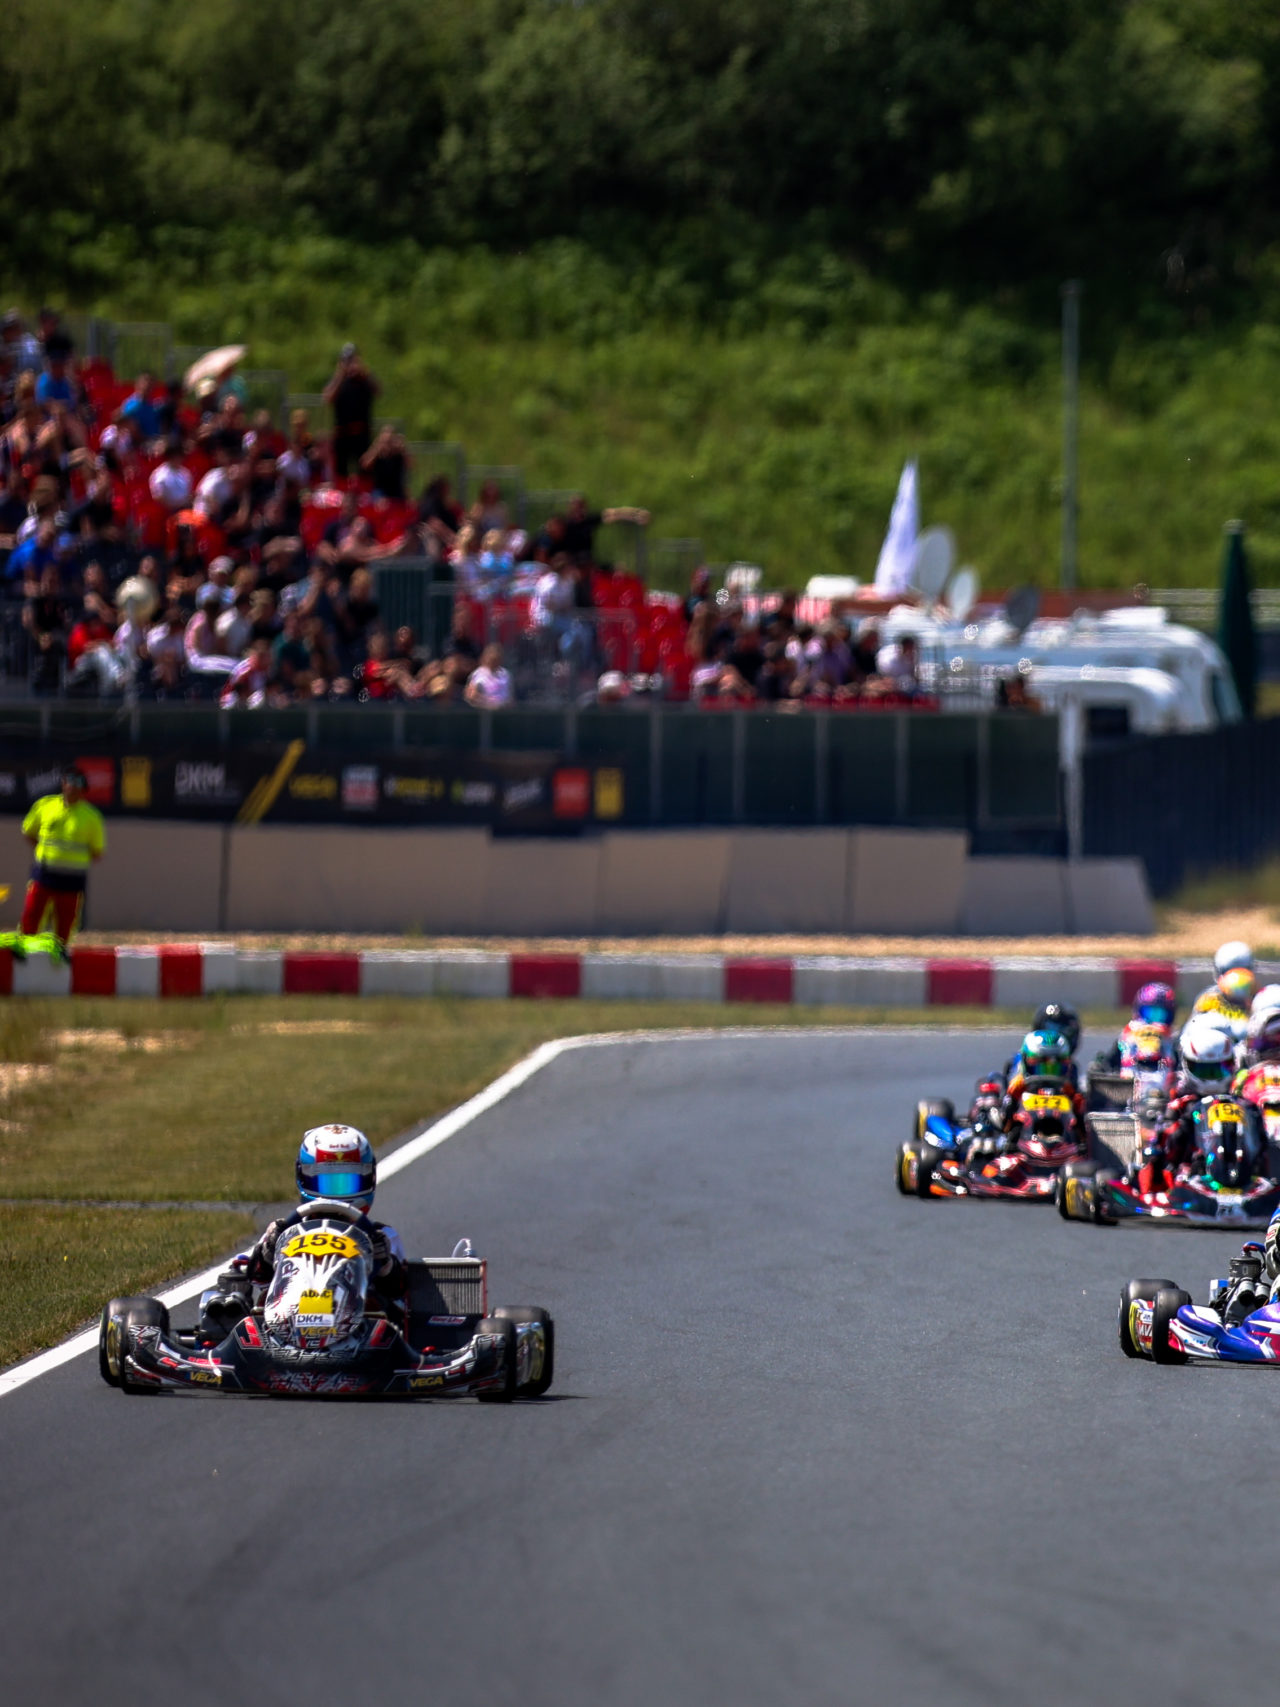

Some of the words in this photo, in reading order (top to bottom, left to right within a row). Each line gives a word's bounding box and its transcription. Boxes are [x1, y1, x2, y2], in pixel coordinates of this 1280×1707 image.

[292, 1233, 347, 1252] 155
[300, 1327, 338, 1336] VEGA
[189, 1371, 223, 1384] VEGA
[409, 1376, 444, 1387] VEGA
